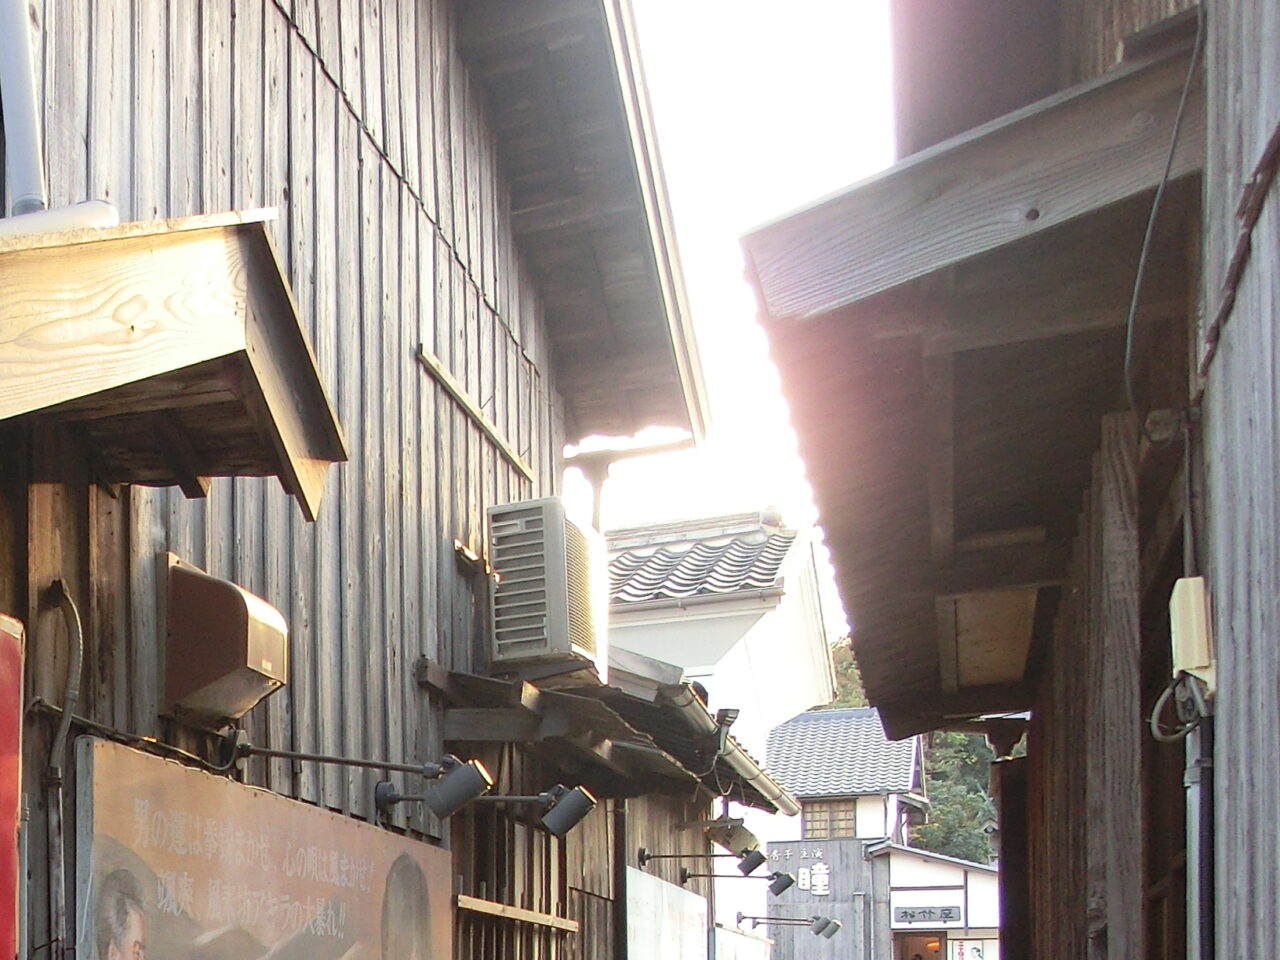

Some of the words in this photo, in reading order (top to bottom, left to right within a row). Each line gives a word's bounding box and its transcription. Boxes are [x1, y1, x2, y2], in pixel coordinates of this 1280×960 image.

[798, 862, 831, 896] 瞳
[900, 908, 954, 919] 松竹座
